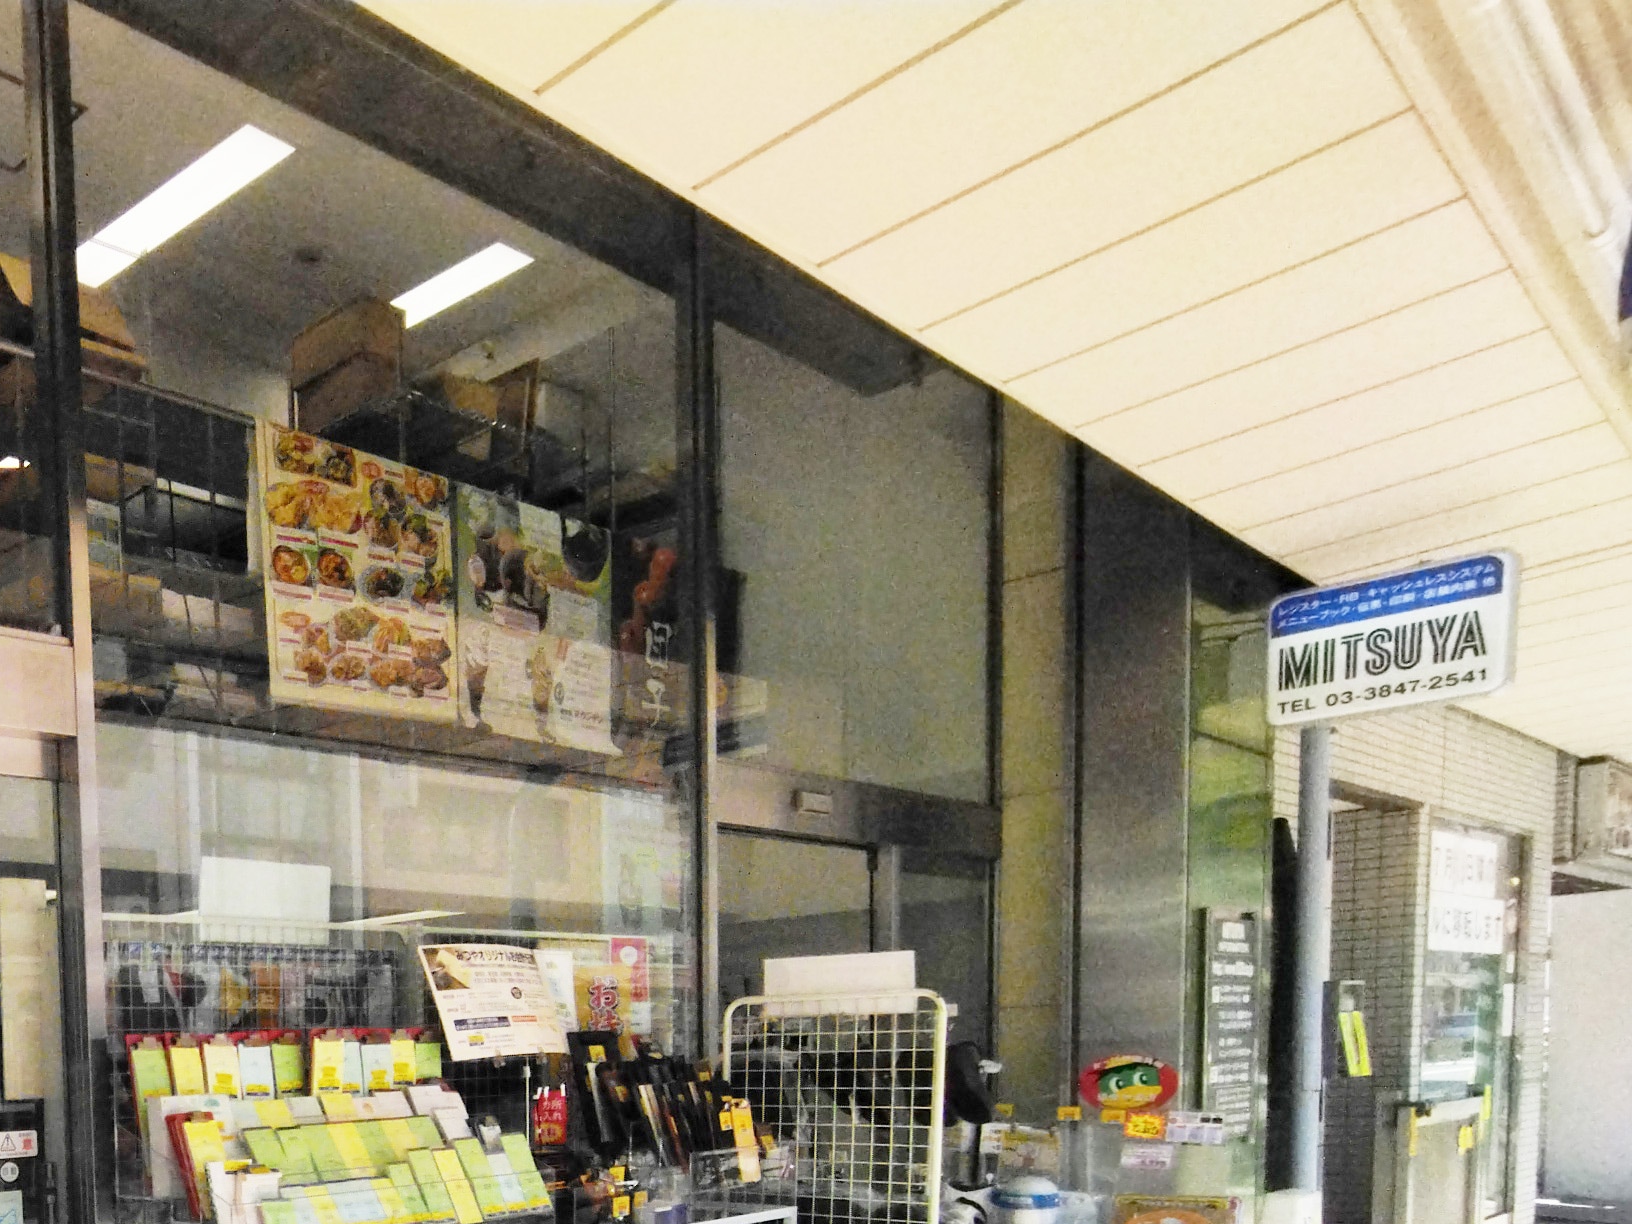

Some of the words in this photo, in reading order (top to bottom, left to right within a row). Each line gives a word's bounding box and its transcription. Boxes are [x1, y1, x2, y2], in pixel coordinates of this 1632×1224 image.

[1277, 610, 1488, 691] MITSUYA
[1277, 700, 1317, 716] TEL
[1325, 668, 1488, 708] 03-3847-2541
